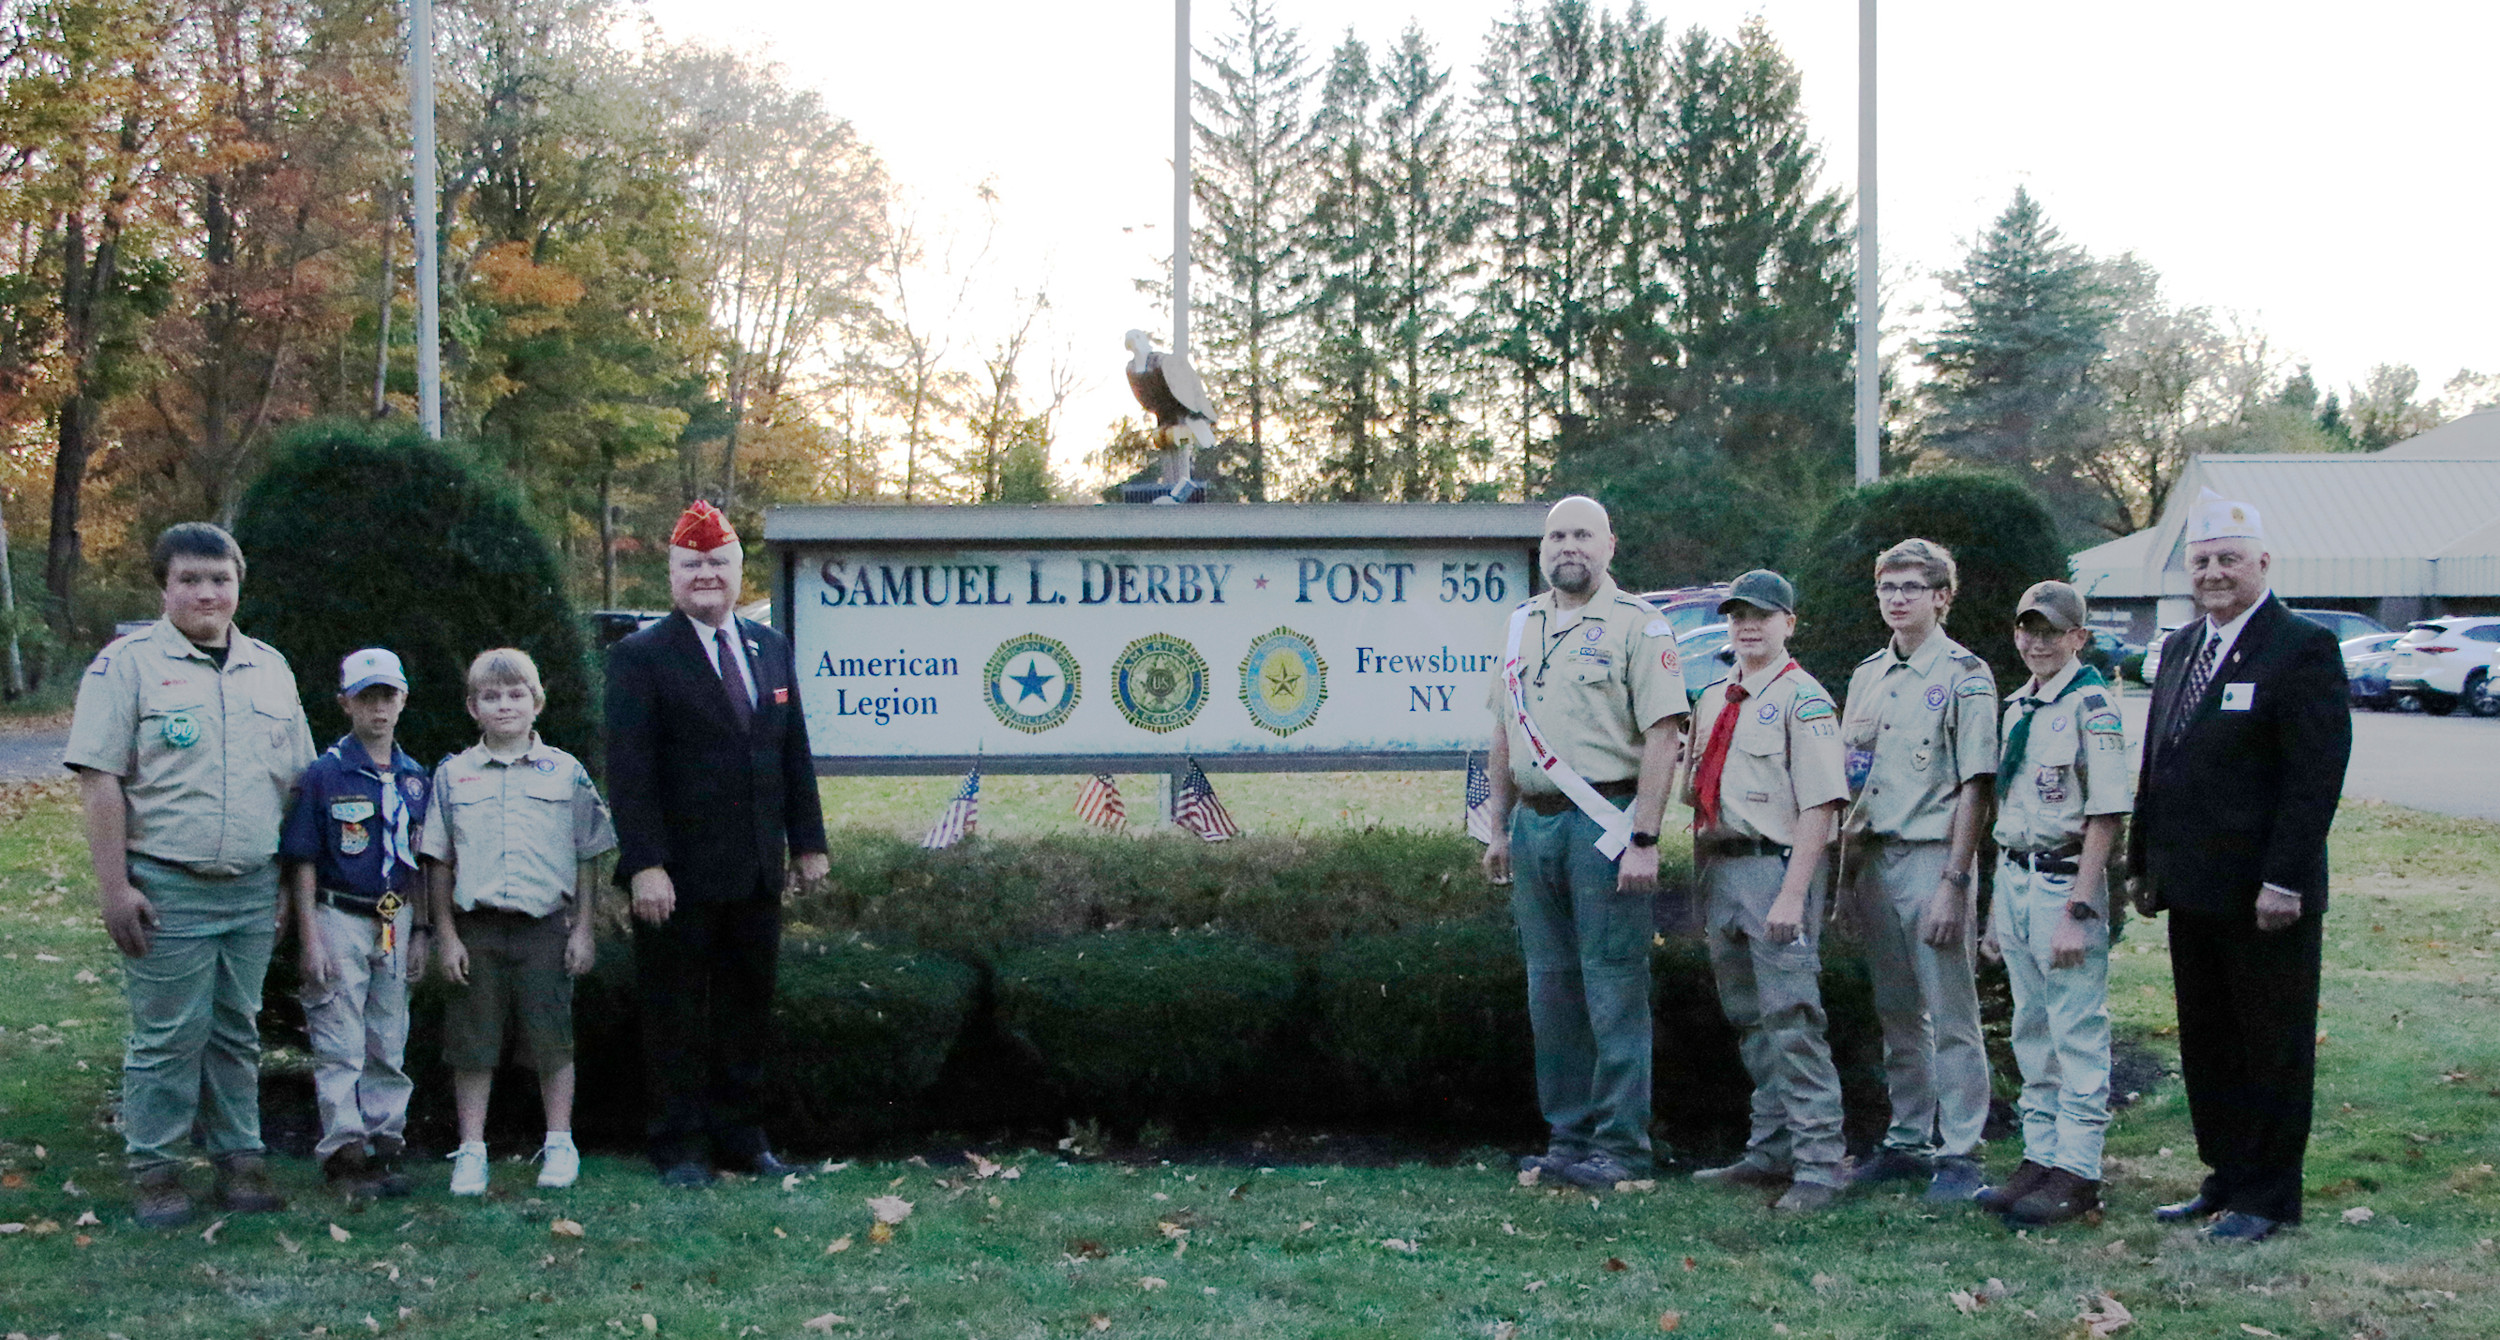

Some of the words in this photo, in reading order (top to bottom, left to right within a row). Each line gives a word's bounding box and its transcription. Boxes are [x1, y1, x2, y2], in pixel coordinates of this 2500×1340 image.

[820, 557, 1012, 606] SAMUEL
[1026, 557, 1067, 606] L.
[1078, 557, 1235, 604] DERBY
[1294, 556, 1416, 604] POST
[1439, 561, 1506, 603] 556
[815, 648, 959, 677] American
[991, 641, 1040, 683] AMERICAN
[1042, 644, 1075, 685] LEGION
[1121, 641, 1200, 673] AMERICAN
[1355, 645, 1498, 674] Frewsbur
[837, 688, 939, 726] Legion
[1409, 685, 1457, 713] NY
[1131, 706, 1190, 725] LEGION
